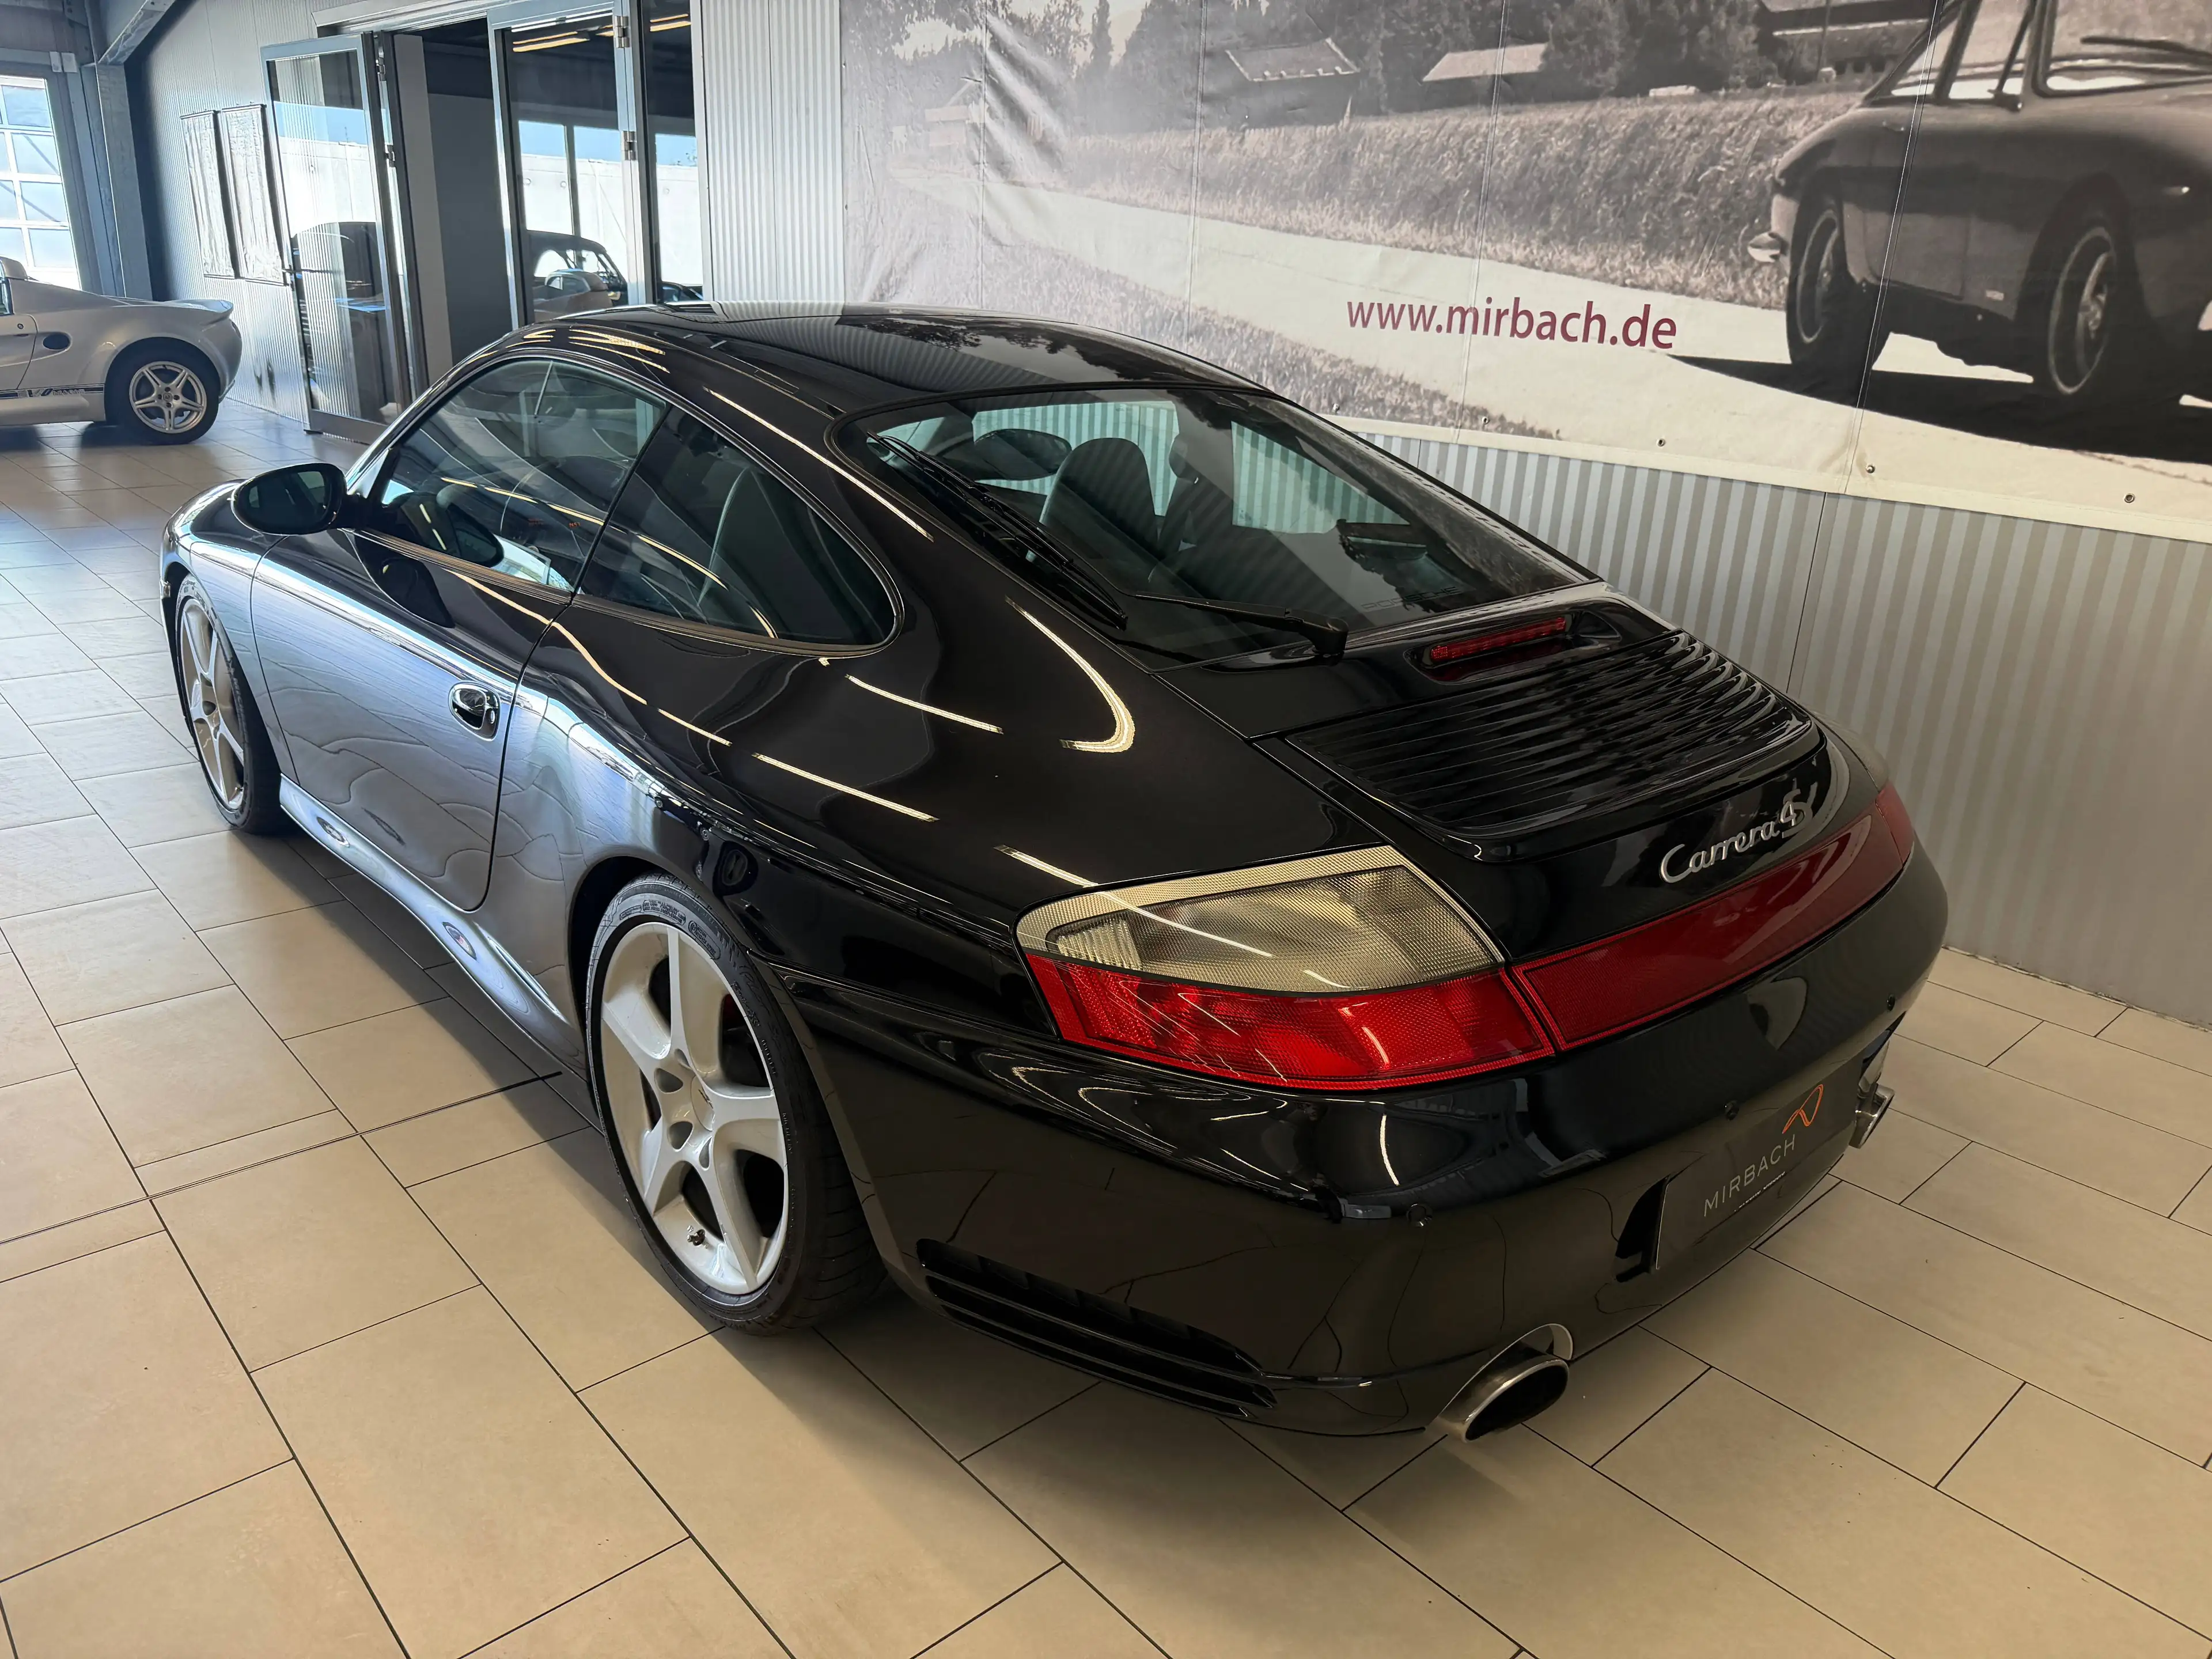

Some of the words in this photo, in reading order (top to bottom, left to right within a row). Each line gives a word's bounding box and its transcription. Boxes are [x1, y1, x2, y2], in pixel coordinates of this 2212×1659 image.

[1347, 297, 1677, 349] www.mirbach.de
[1660, 820, 1780, 884] Carrera
[1703, 1134, 1796, 1217] MIRBACH
